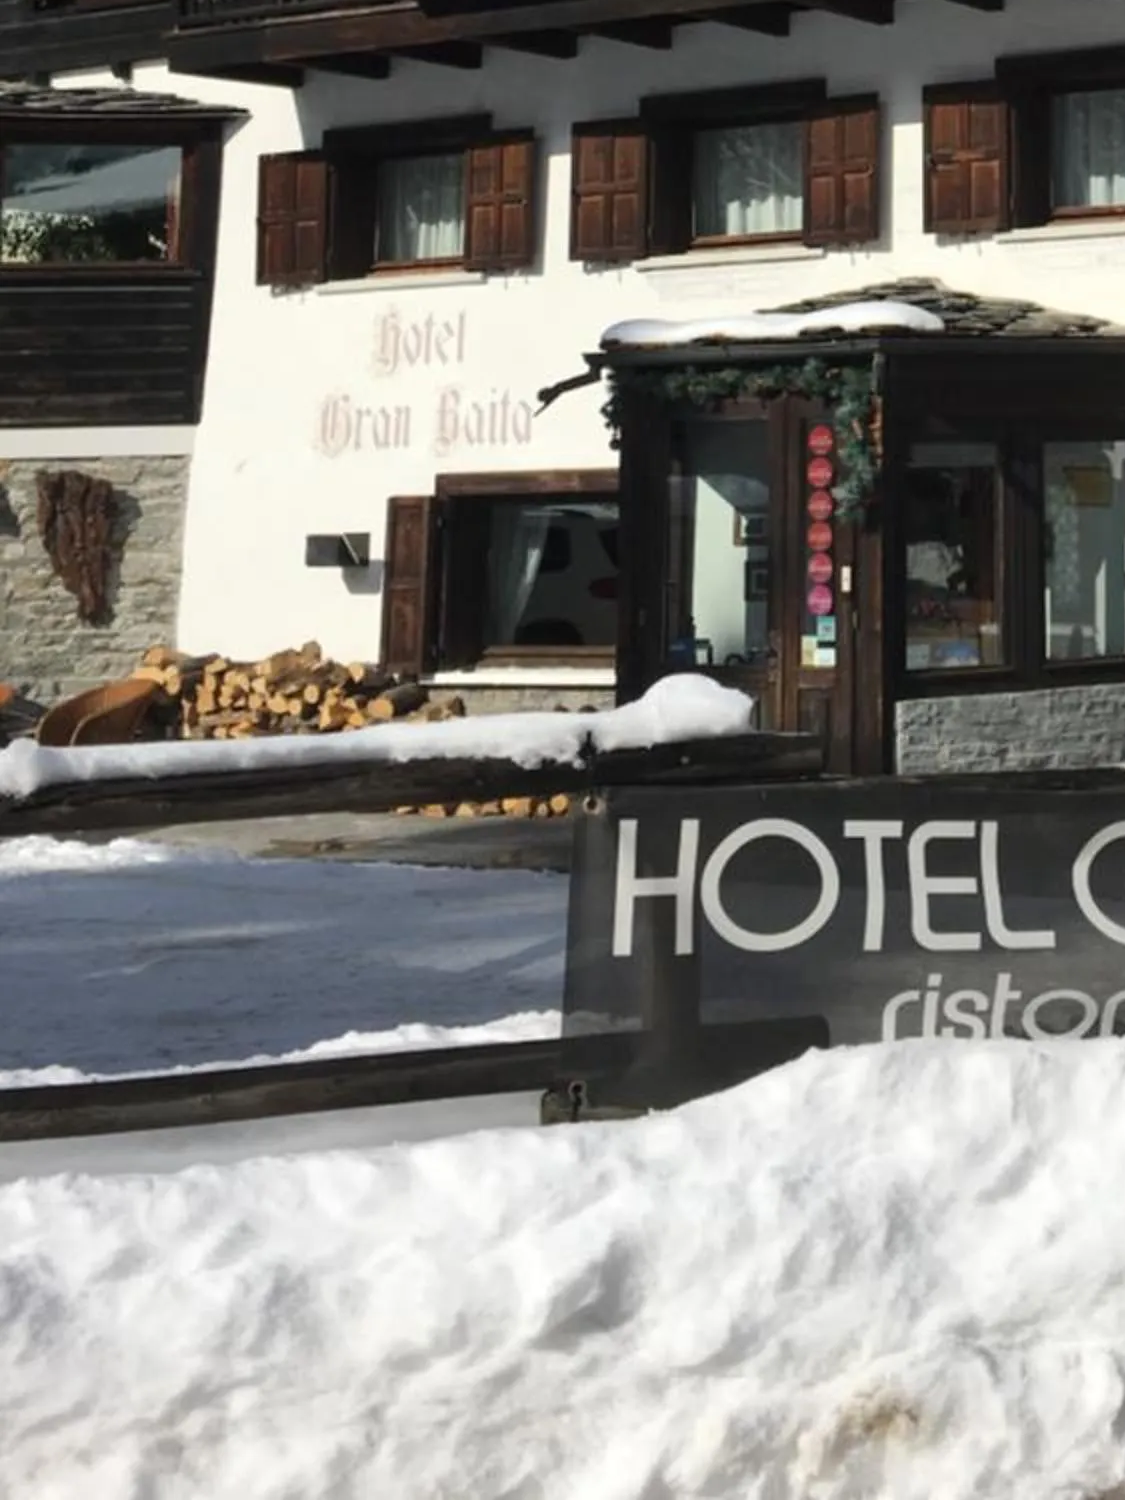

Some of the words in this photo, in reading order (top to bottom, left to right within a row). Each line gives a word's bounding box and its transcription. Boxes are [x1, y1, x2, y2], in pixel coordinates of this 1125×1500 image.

[373, 305, 466, 376] Hotel
[314, 393, 411, 458] Gran
[433, 385, 532, 457] Baita
[613, 818, 1056, 955] HOTEL
